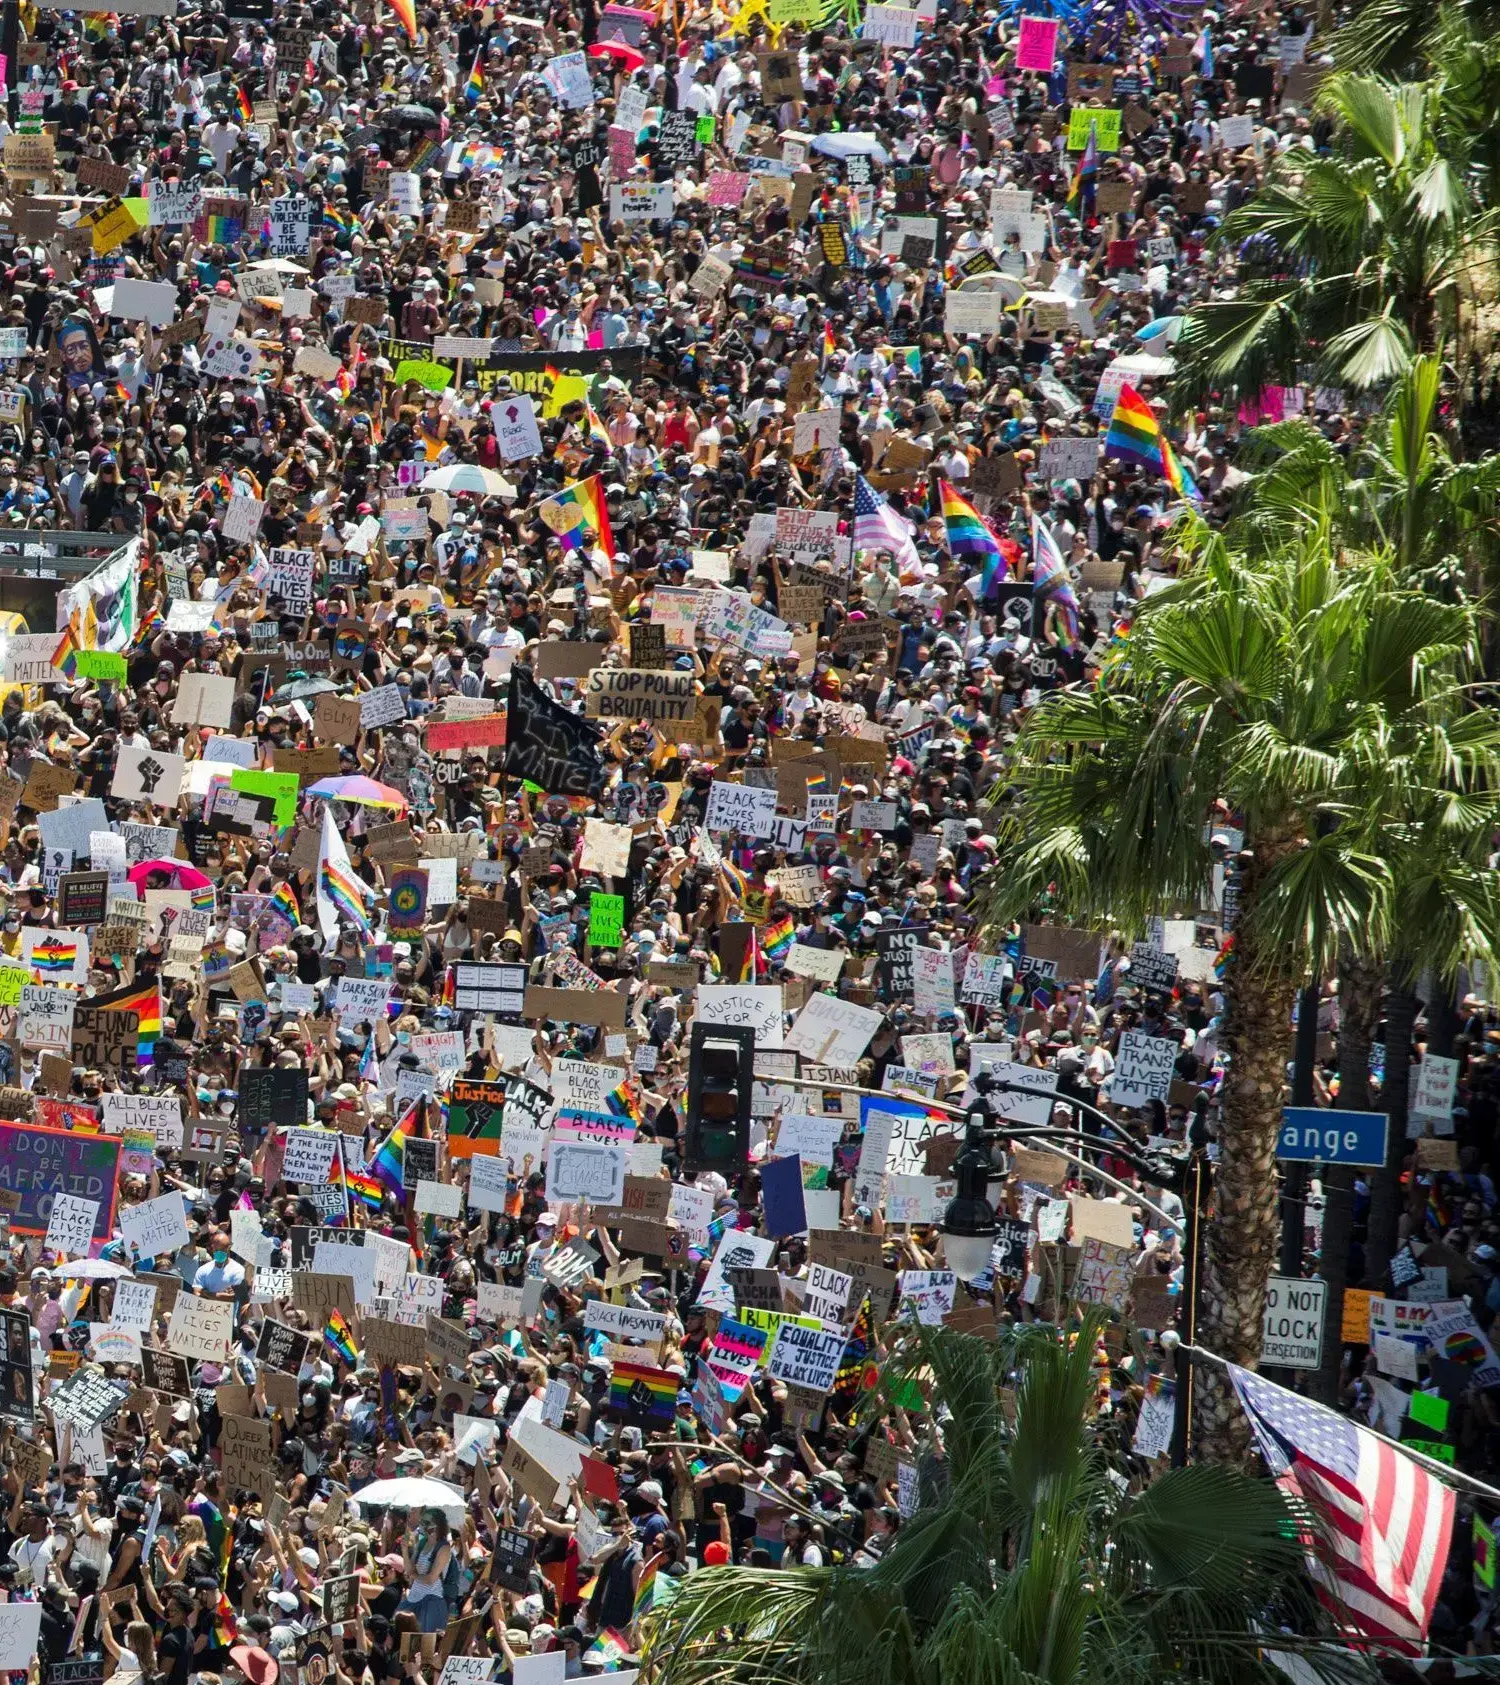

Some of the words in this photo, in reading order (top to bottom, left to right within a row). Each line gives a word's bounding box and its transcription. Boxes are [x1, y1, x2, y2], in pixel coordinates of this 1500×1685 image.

[277, 32, 310, 45] BLACK
[277, 46, 309, 59] LIVES
[580, 143, 592, 151] ALL
[575, 148, 600, 168] BLM
[155, 178, 200, 195] BLACK
[621, 186, 664, 195] Power
[275, 199, 307, 210] STOP
[622, 202, 657, 213] People!
[159, 209, 201, 221] MATTER
[271, 212, 308, 223] VIOLENCE
[282, 224, 295, 234] BE
[279, 235, 298, 244] THE
[1151, 238, 1175, 257] BLM
[270, 244, 308, 255] CHANGE
[241, 274, 275, 288] BLACK
[245, 284, 278, 298] LIVES
[777, 510, 814, 524] STOP
[273, 551, 311, 565] BLACK
[328, 559, 361, 575] BLM
[271, 579, 309, 598] LIVES
[256, 636, 275, 651] WE
[284, 642, 303, 660] No
[305, 641, 330, 660] One
[14, 660, 57, 679] MATTER
[1030, 654, 1056, 677] BLM
[589, 671, 640, 693] STOP
[645, 673, 696, 696] POLICE
[599, 694, 688, 718] BRUTALITY
[322, 709, 353, 727] BLM
[718, 789, 757, 808] BLACK
[726, 807, 754, 820] LIVES
[114, 902, 145, 914] WHITE
[98, 926, 133, 938] BLACK
[1134, 947, 1179, 967] EVERYONE
[1019, 959, 1056, 975] BLM
[23, 986, 56, 1003] BLUE
[703, 992, 765, 1019] JUSTICE
[24, 1022, 70, 1042] SKIN
[91, 1031, 123, 1046] THE
[1124, 1033, 1176, 1055] BLACK
[1122, 1048, 1172, 1069] TRANS
[558, 1063, 600, 1076] LATINOS
[602, 1068, 619, 1081] FOR
[1019, 1072, 1055, 1086] TRANS
[1118, 1064, 1170, 1085] LIVES
[454, 1084, 505, 1103] Justice
[1113, 1077, 1169, 1100] MATTER
[108, 1096, 135, 1112] ALL
[137, 1097, 179, 1112] BLACK
[124, 1113, 168, 1128] LIVES
[572, 1113, 625, 1134] BLACK
[15, 1132, 91, 1153] DON'T
[1282, 1123, 1359, 1157] ange
[39, 1156, 61, 1171] BE
[58, 1196, 91, 1213] ALL
[308, 1229, 355, 1245] BLACK
[498, 1250, 522, 1266] BLM
[545, 1249, 592, 1281] BLM
[813, 1269, 848, 1297] BLACK
[1287, 1291, 1321, 1312] NOT
[184, 1314, 221, 1331] LIVES
[1268, 1317, 1317, 1340] LOCK
[779, 1325, 846, 1349] EQUALITY
[714, 1348, 752, 1367] LIVES
[1263, 1341, 1317, 1359] TERSECTION
[794, 1349, 837, 1370] JUSTICE
[782, 1363, 807, 1381] BLACK
[805, 1370, 833, 1388] LIVES
[227, 1472, 262, 1489] BLM
[53, 1666, 99, 1678] BLACK
[446, 1658, 484, 1676] BLACK
